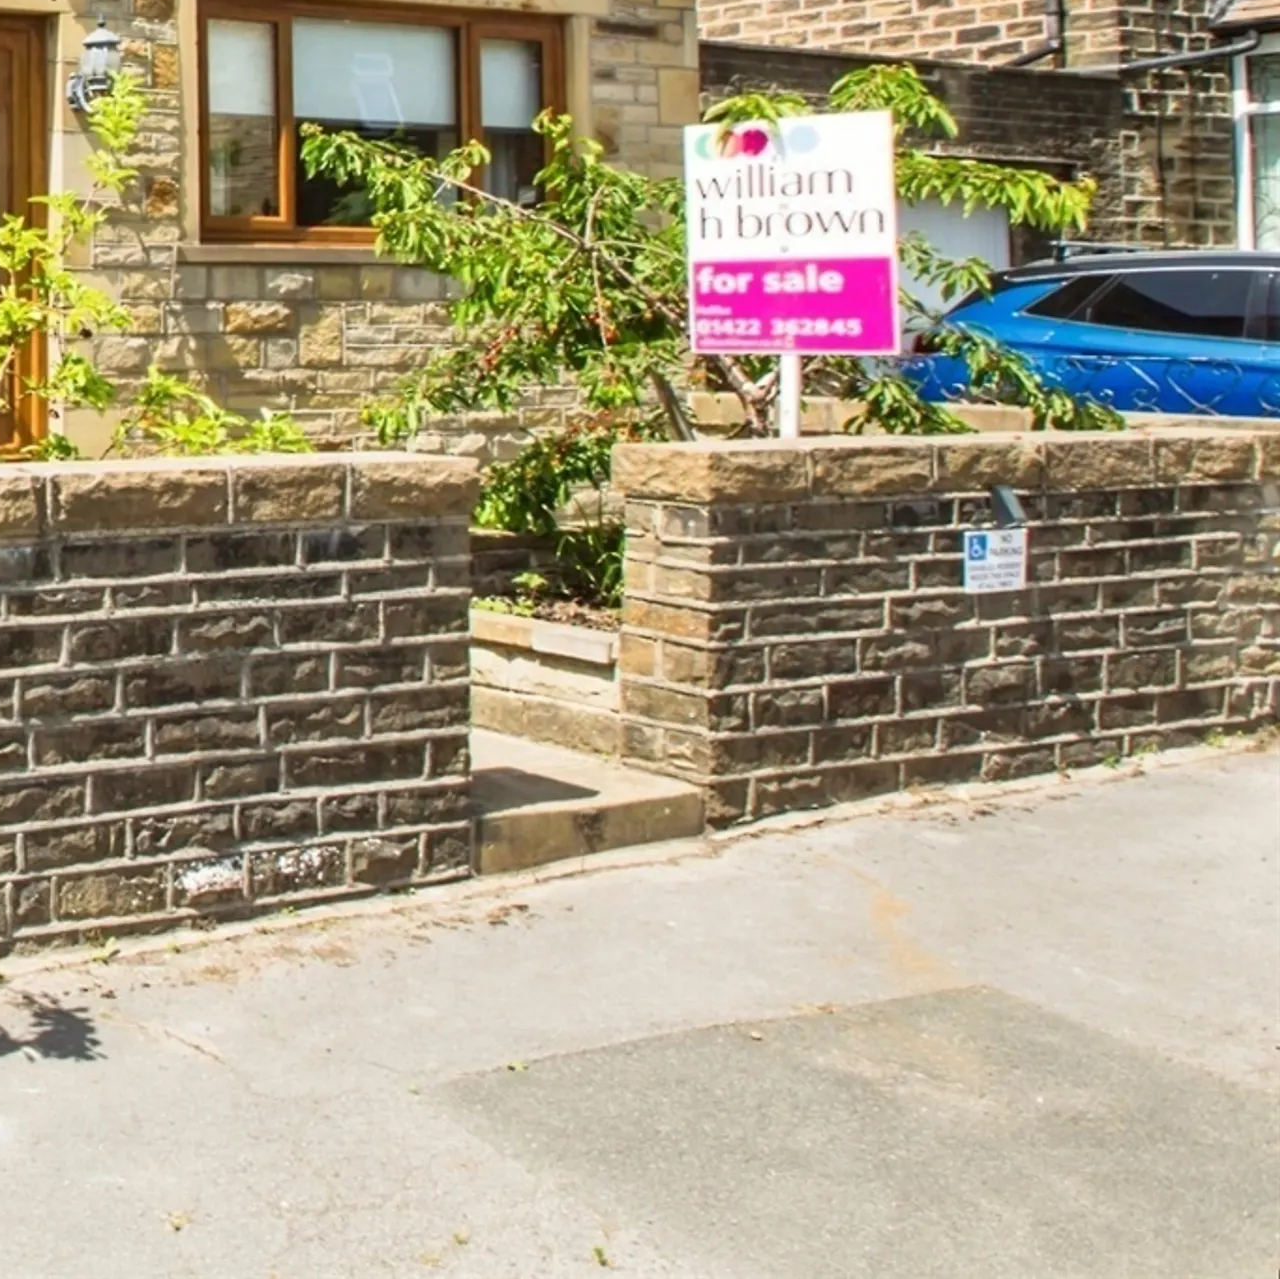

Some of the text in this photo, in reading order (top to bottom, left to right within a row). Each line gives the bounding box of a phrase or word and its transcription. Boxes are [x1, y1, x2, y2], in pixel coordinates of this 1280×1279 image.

[695, 163, 853, 200] william
[700, 204, 885, 239] h brown
[696, 263, 845, 294] for sale
[696, 317, 761, 336] 01422
